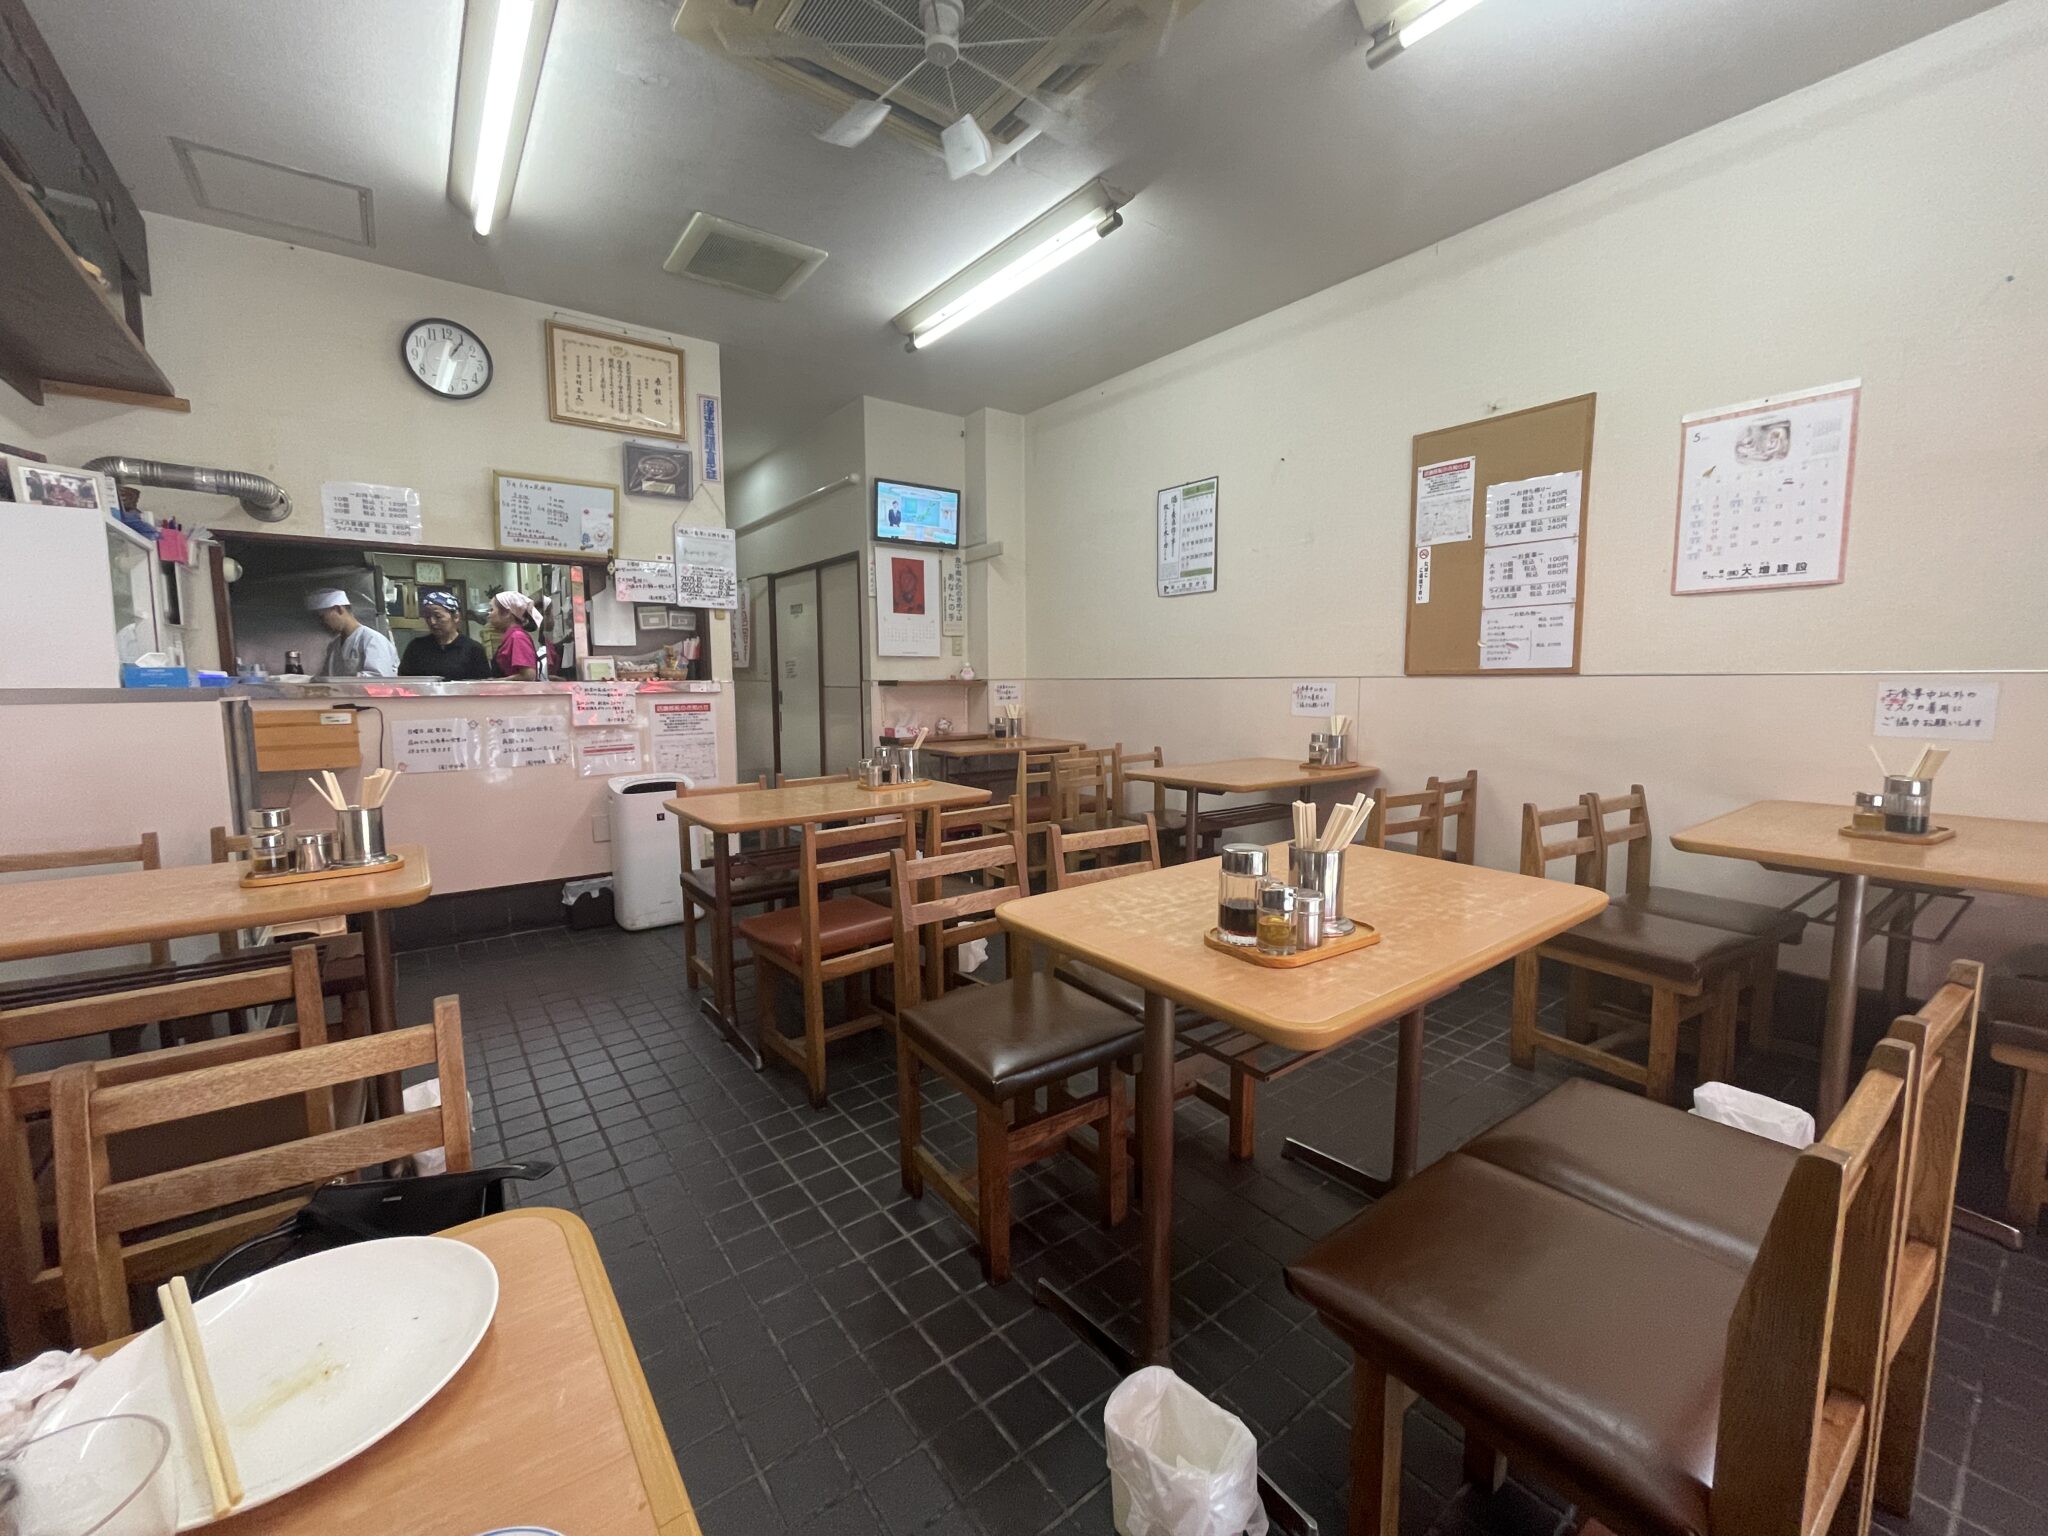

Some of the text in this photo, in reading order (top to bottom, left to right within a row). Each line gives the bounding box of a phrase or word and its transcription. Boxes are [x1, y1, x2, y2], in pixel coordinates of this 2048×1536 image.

[428, 328, 436, 341] 11
[442, 328, 453, 340] 12
[415, 335, 426, 348] 10
[469, 345, 476, 358] 2
[471, 373, 478, 384] 4
[1885, 687, 1977, 700] お食事中以外の
[1884, 701, 1962, 714] マスクの着用に
